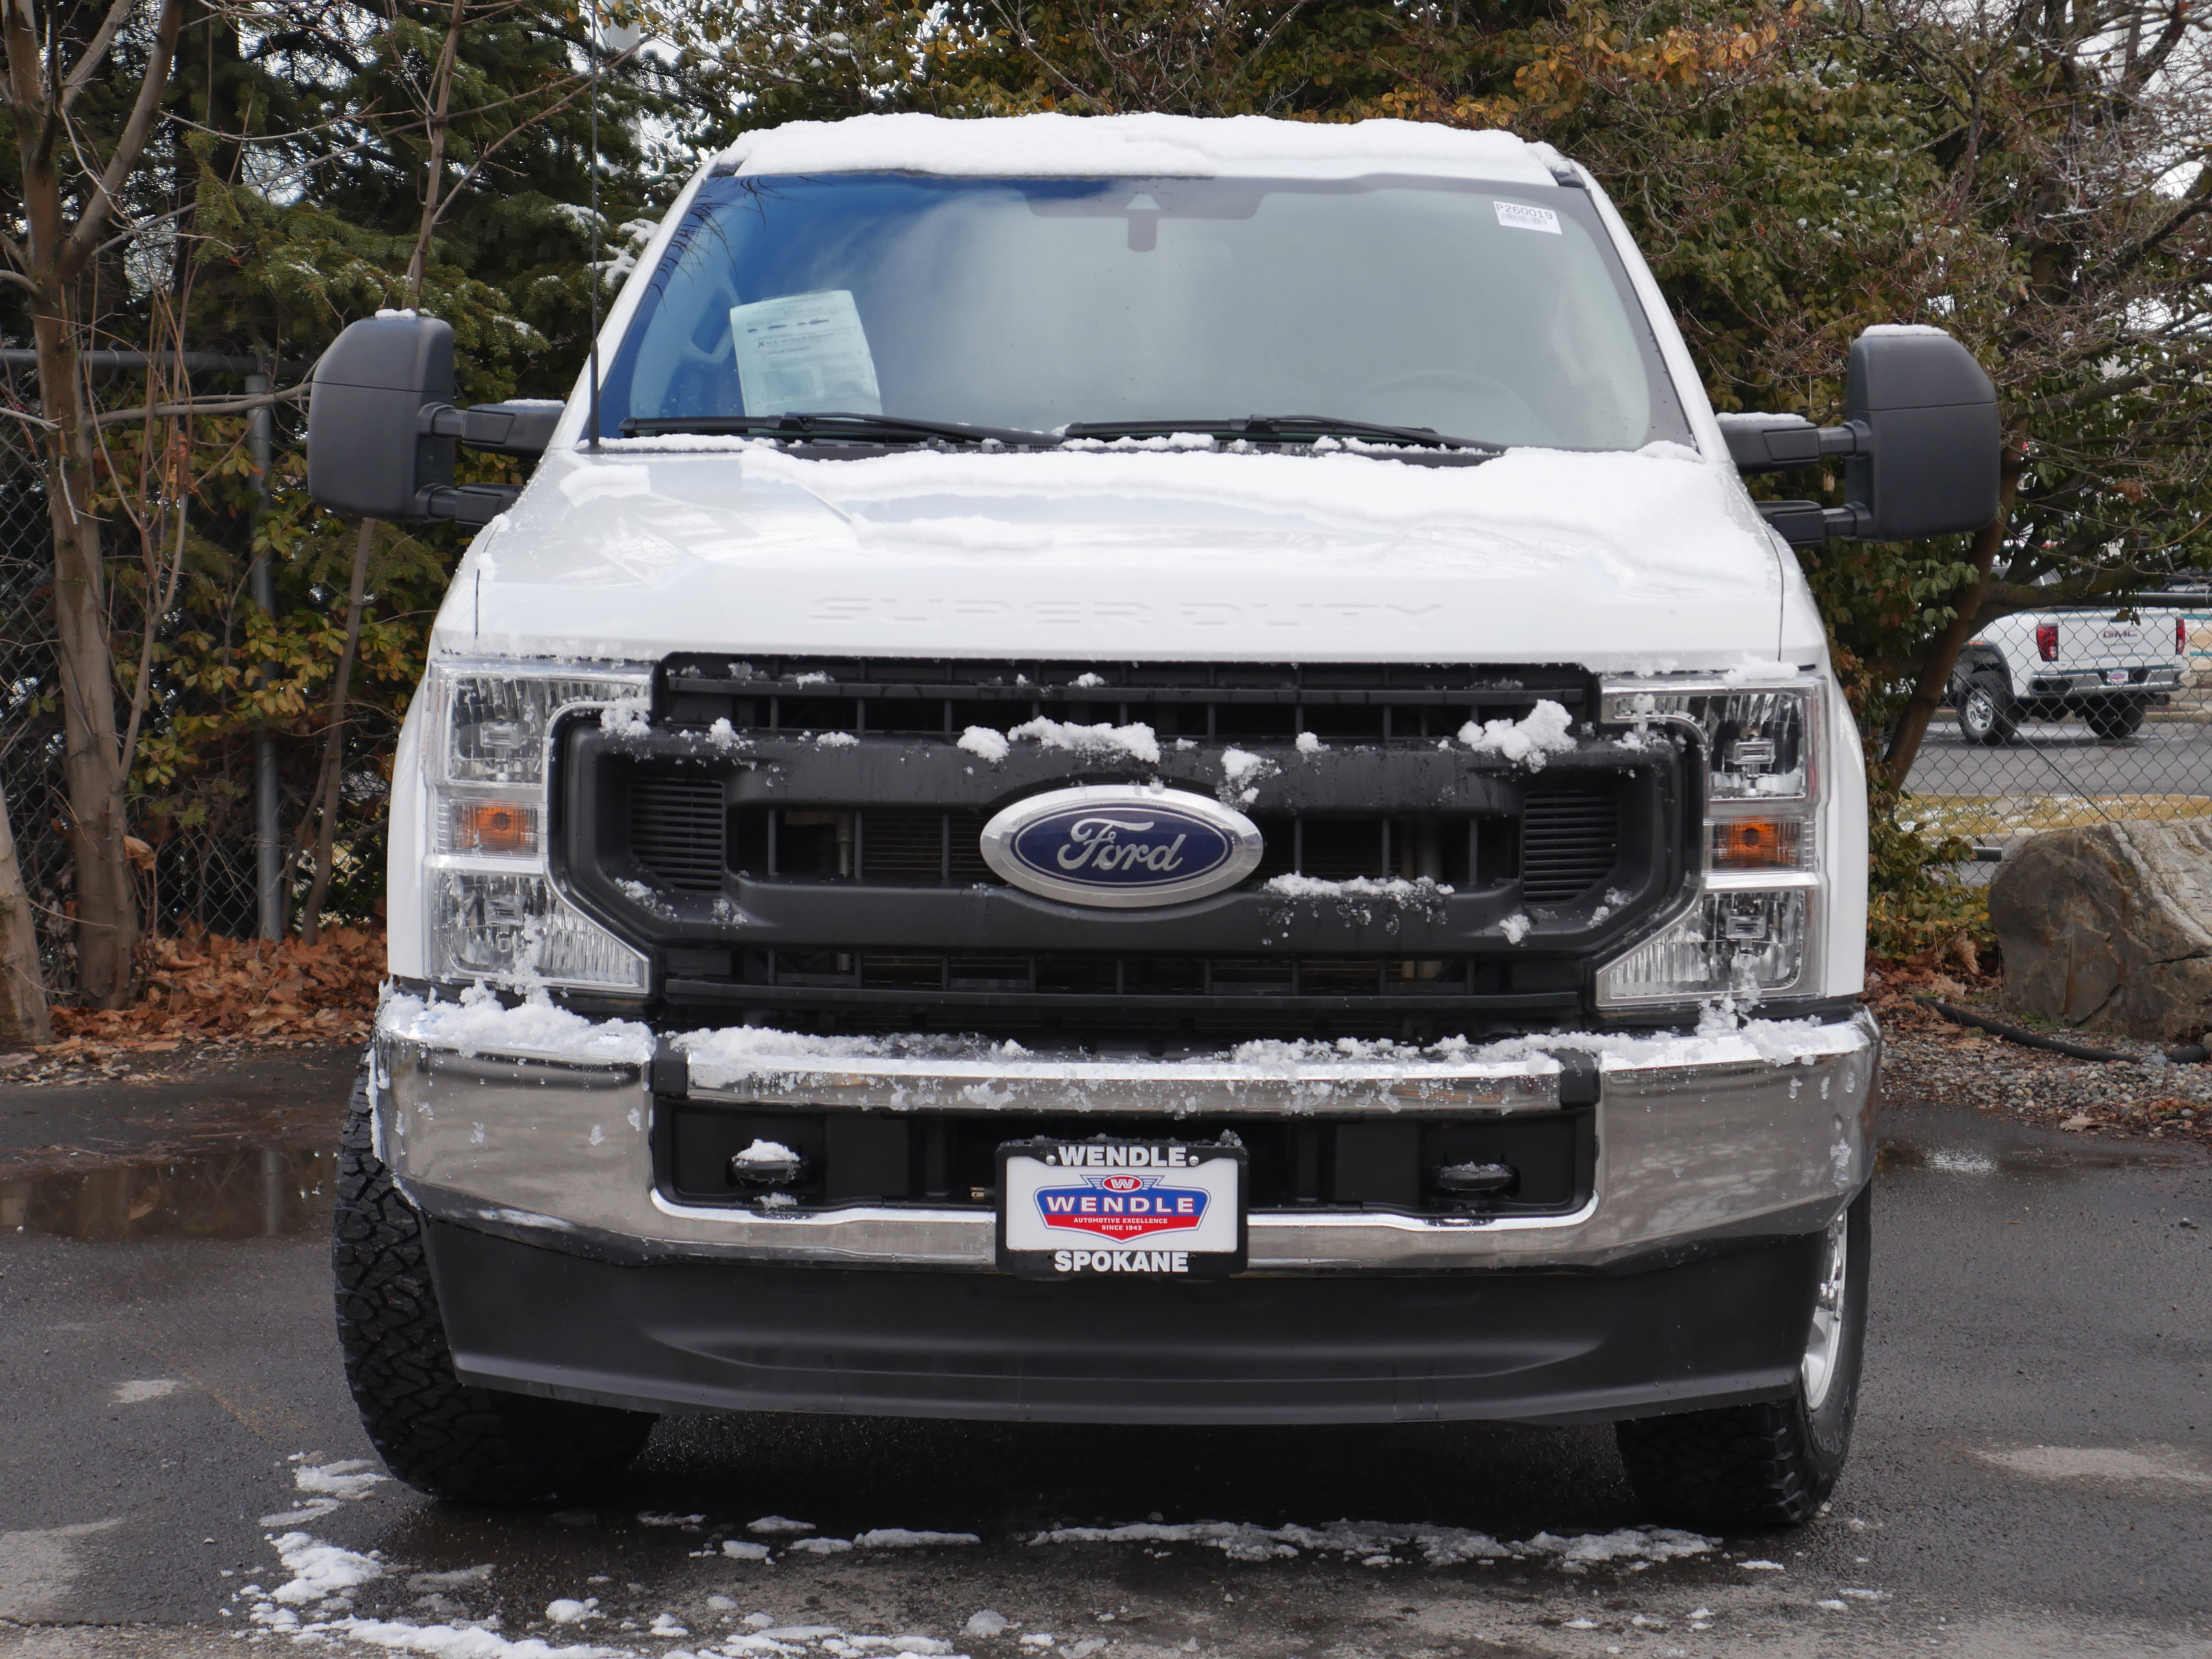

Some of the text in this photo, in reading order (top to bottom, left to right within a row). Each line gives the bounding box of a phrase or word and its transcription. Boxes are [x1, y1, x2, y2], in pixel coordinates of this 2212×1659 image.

[1495, 203, 1553, 220] P260019
[810, 597, 1443, 630] SUPER DUTY
[2103, 630, 2137, 638] GMC
[1057, 818, 1187, 871] Ford
[1058, 1146, 1187, 1167] WENDLE
[1046, 1196, 1194, 1213] WENDLE
[1055, 1250, 1189, 1273] SPOKANE
